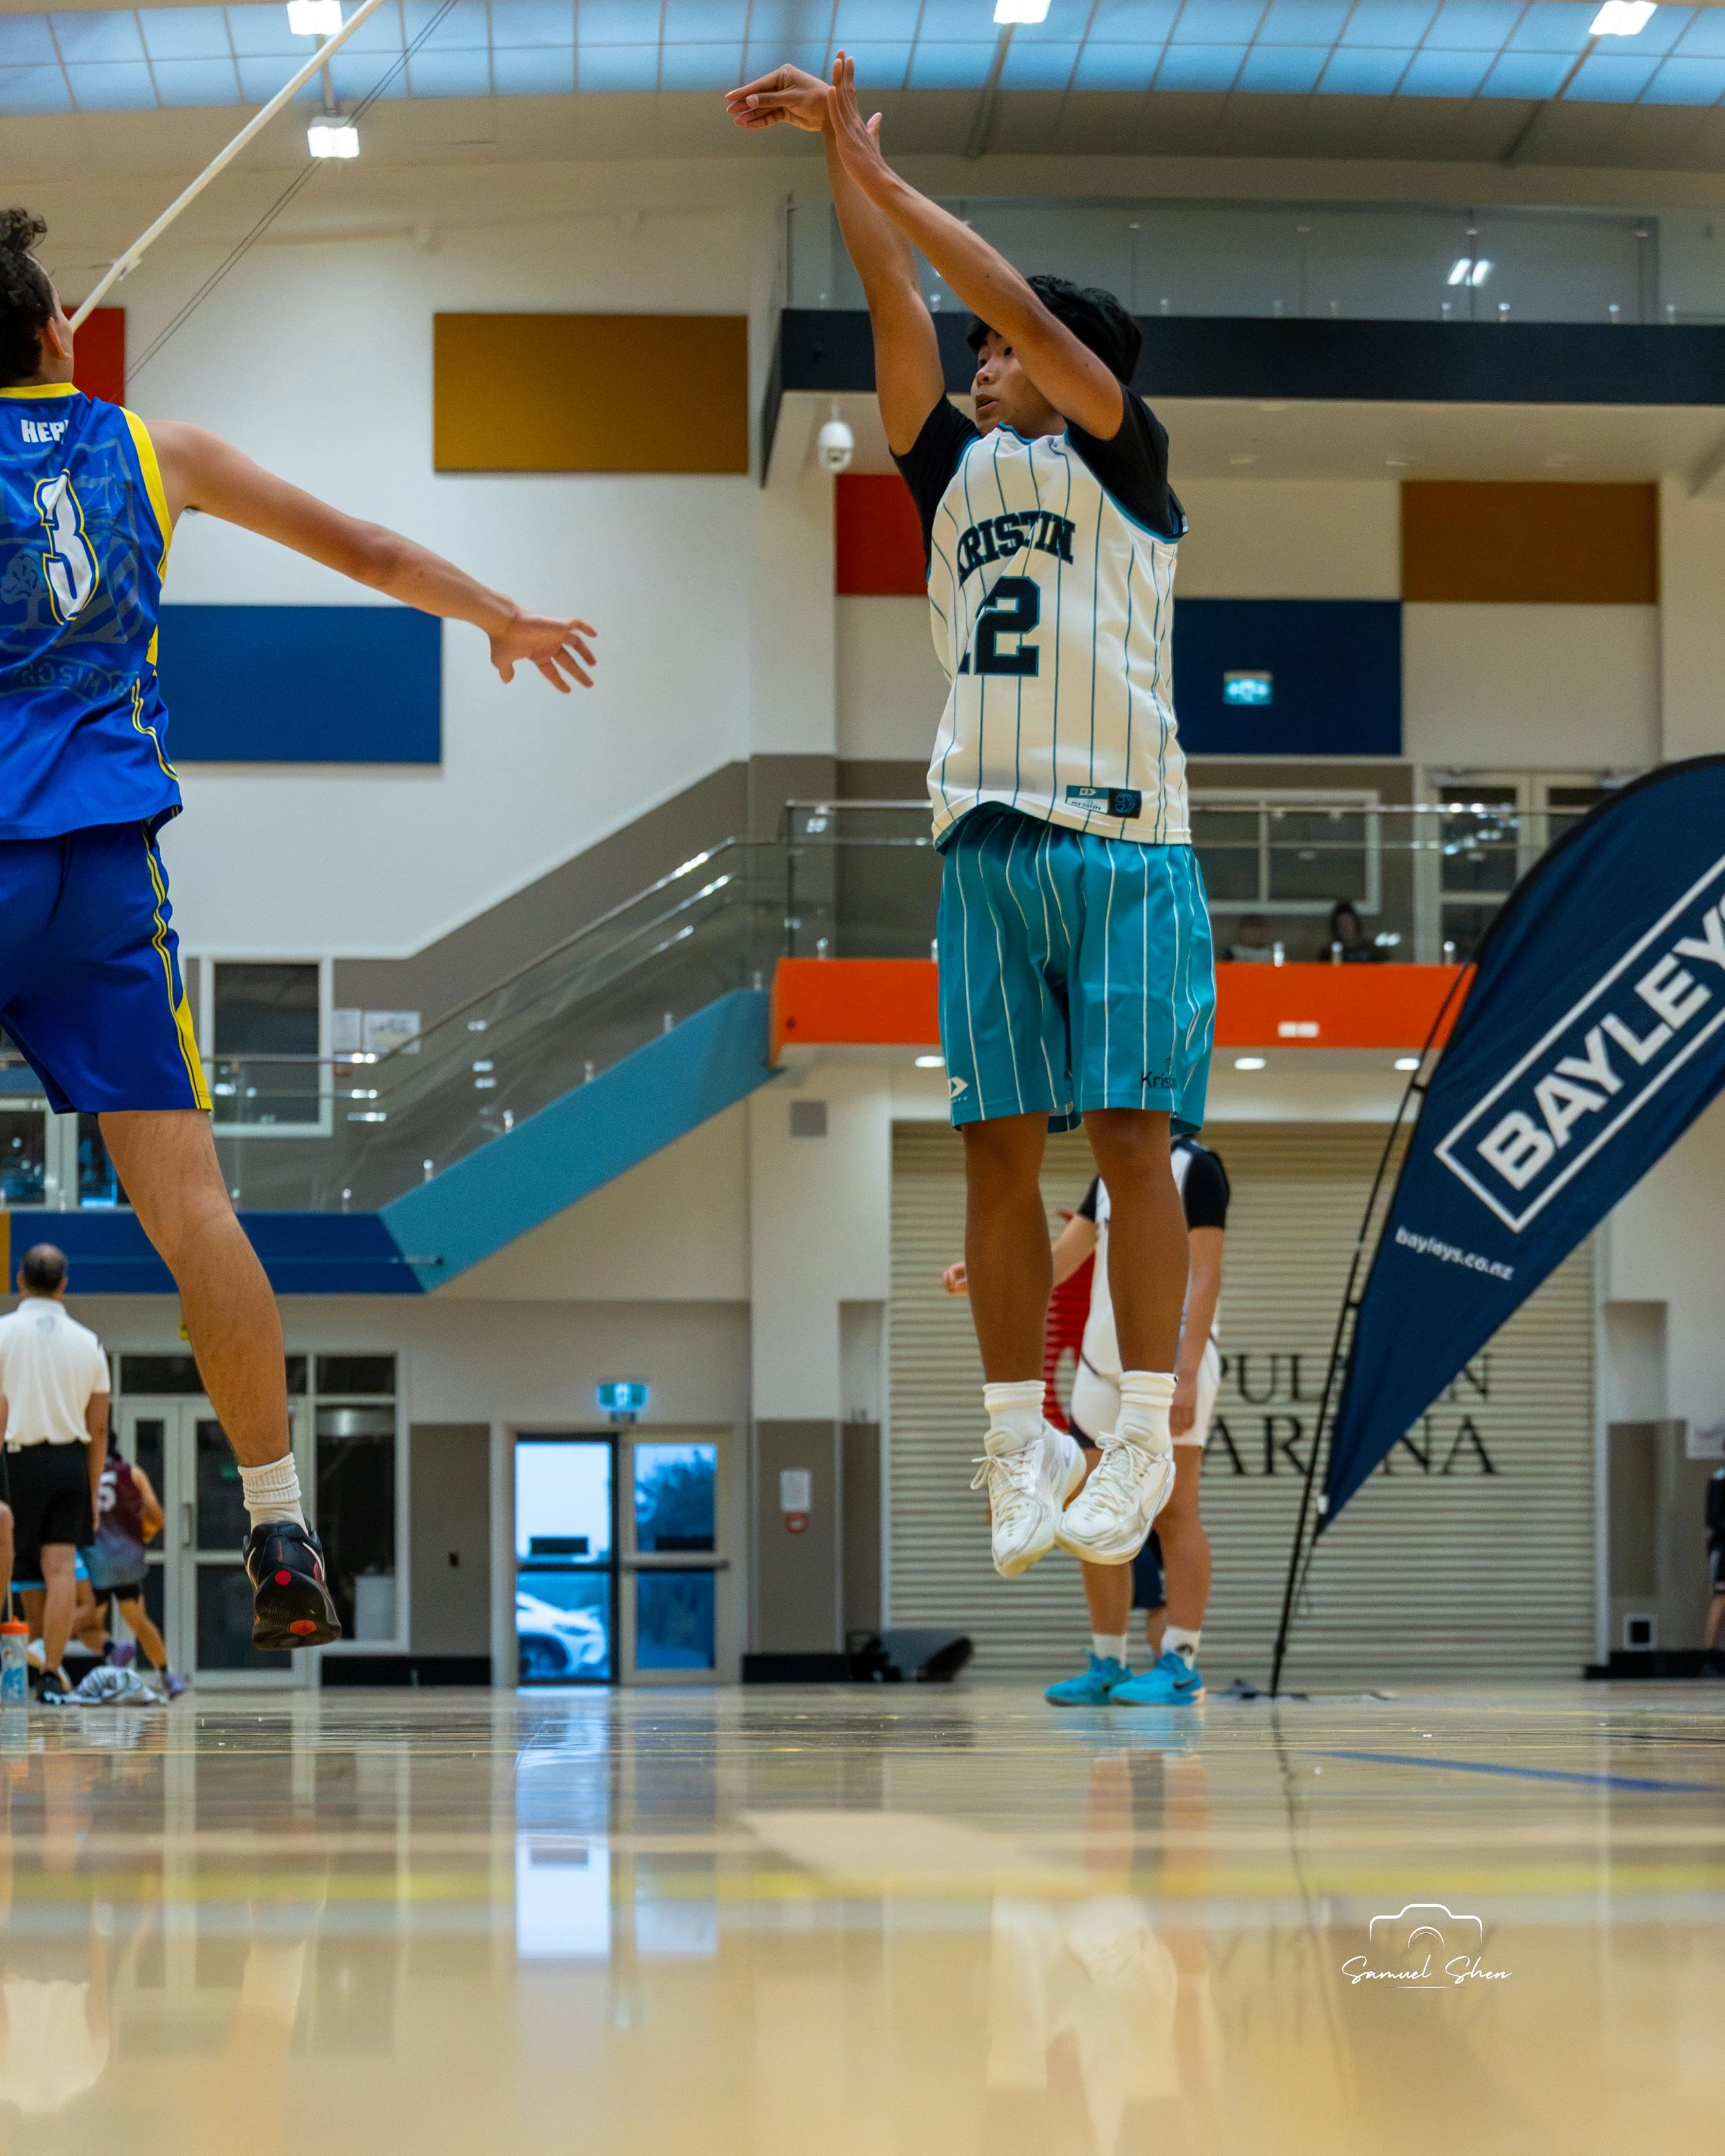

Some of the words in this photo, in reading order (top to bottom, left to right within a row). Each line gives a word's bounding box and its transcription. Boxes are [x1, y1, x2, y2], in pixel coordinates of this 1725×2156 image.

[34, 468, 99, 625] 3
[958, 575, 1041, 678] 2
[1476, 893, 1725, 1191] BAYLEY
[1394, 1225, 1516, 1281] bayleys.co.nz
[1202, 1414, 1504, 1476] ARNA
